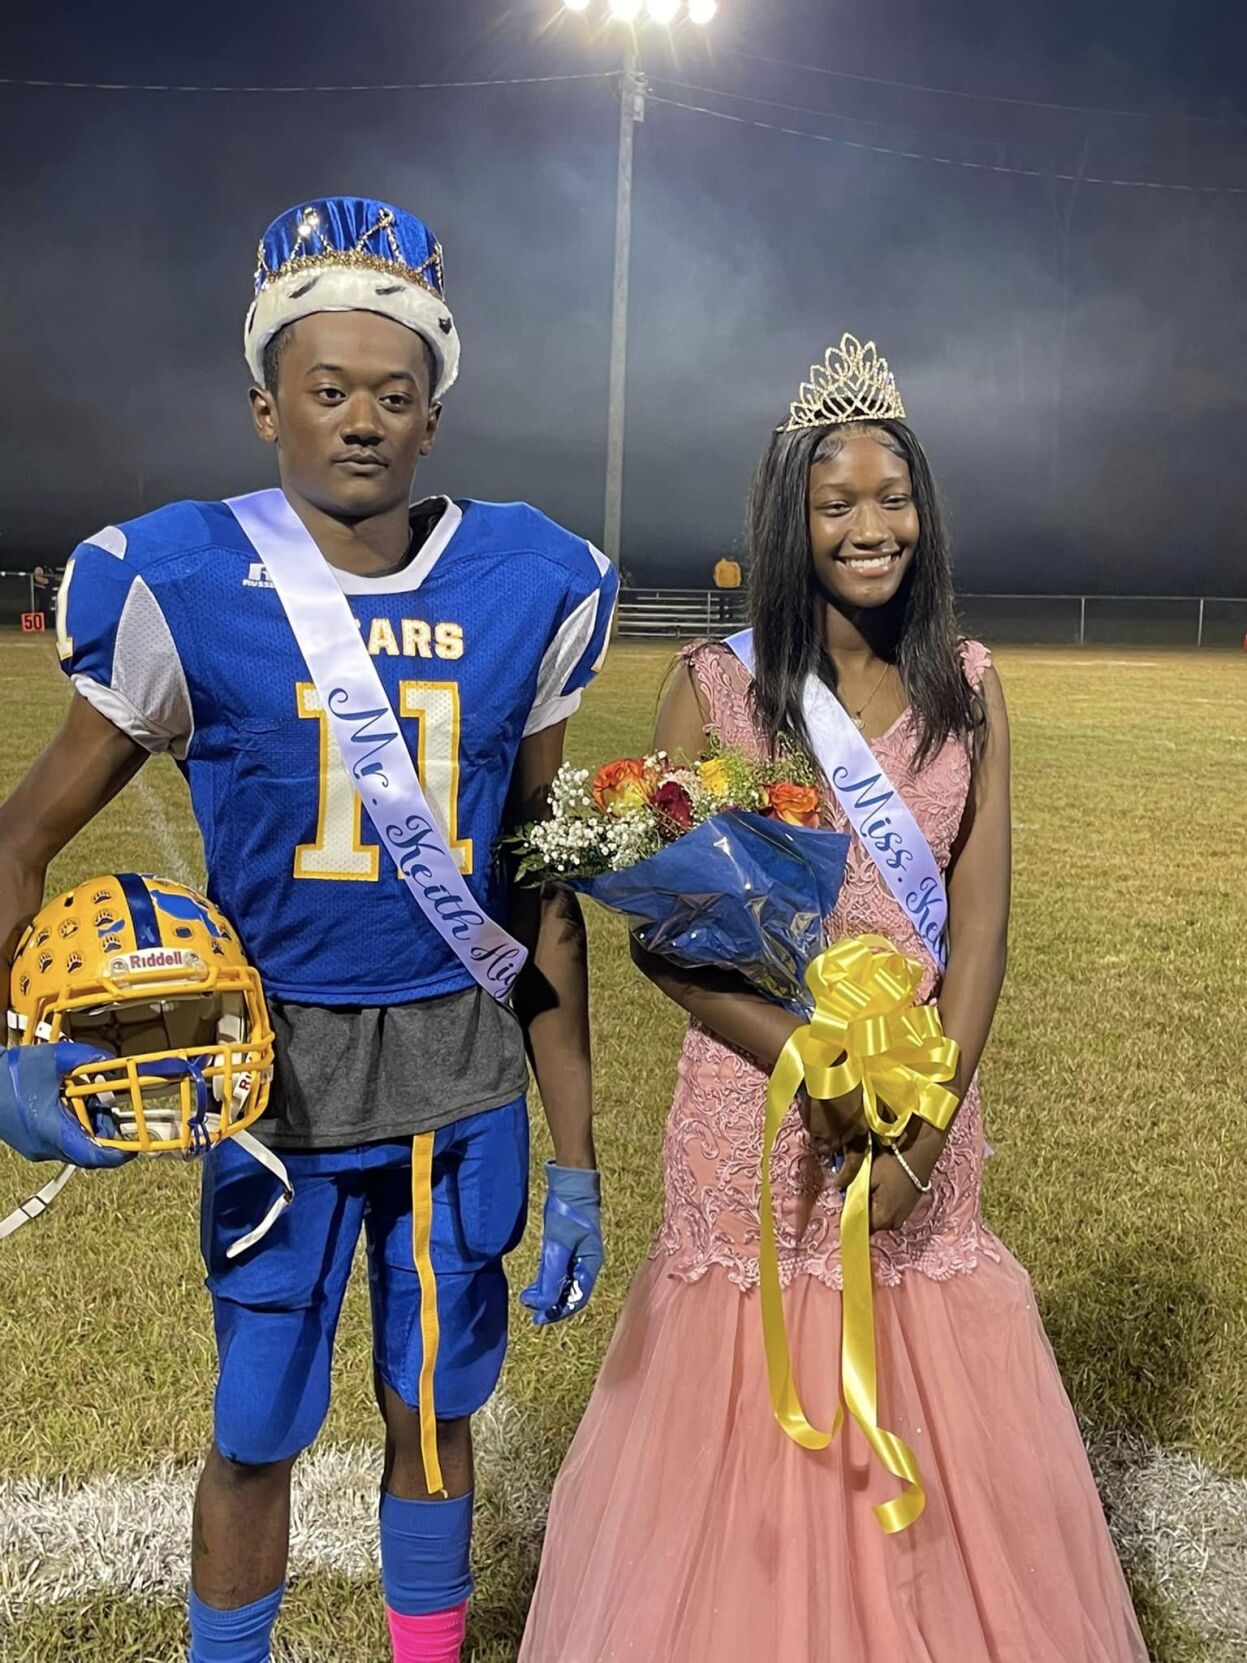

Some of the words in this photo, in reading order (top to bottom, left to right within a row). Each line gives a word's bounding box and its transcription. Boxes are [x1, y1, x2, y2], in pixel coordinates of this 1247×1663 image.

[24, 614, 43, 630] 50
[354, 617, 464, 660] ARS
[293, 680, 473, 882] 11
[328, 687, 399, 806] Mr.
[386, 815, 485, 942] Keith
[832, 766, 914, 883] Miss.
[130, 951, 182, 969] Riddell
